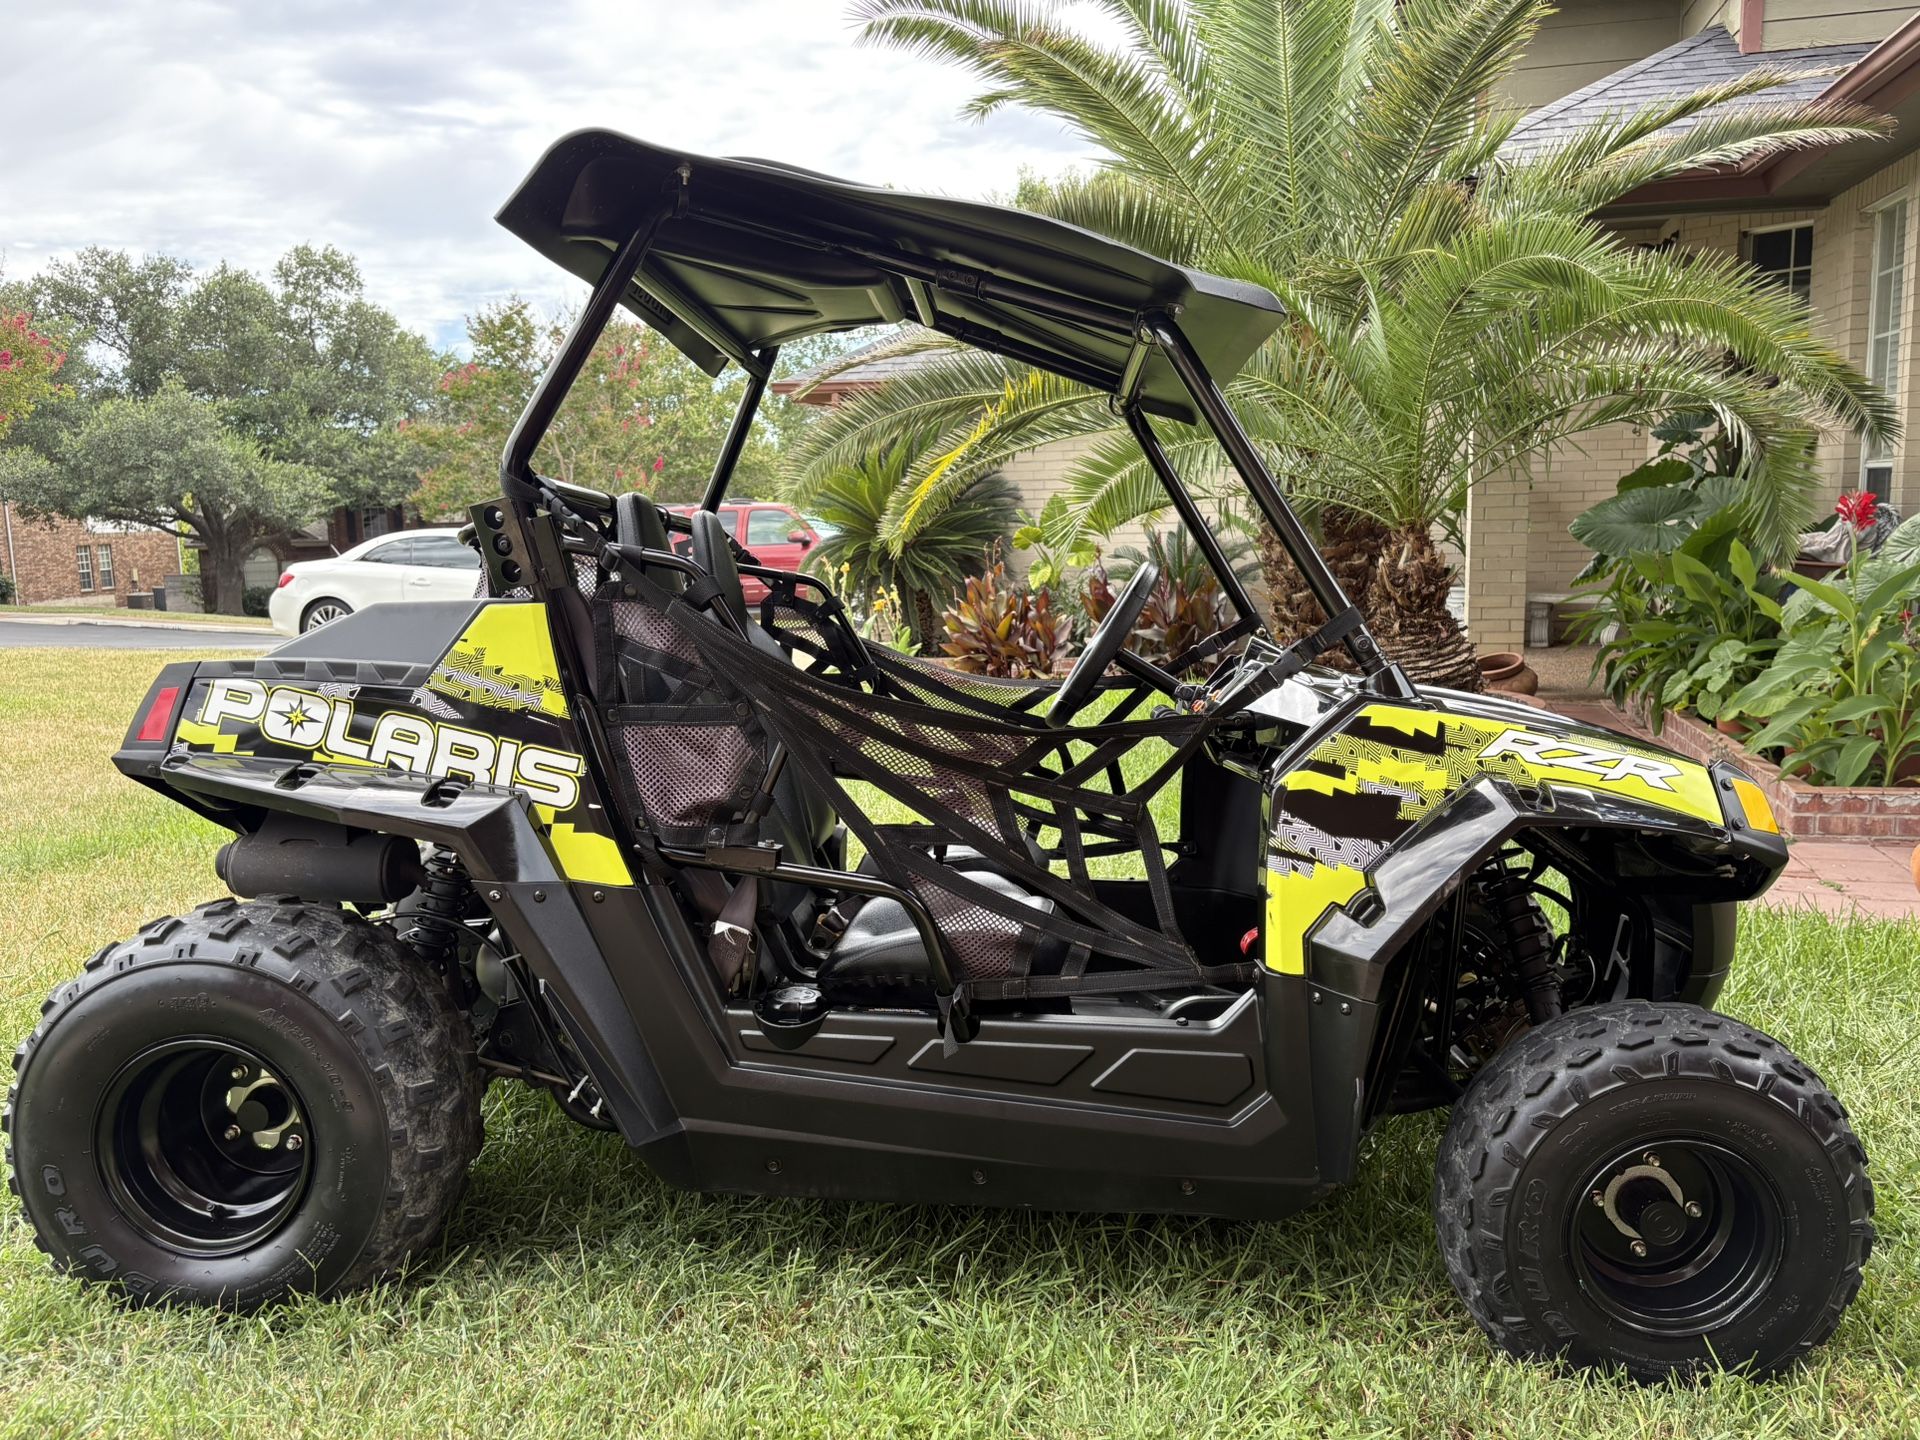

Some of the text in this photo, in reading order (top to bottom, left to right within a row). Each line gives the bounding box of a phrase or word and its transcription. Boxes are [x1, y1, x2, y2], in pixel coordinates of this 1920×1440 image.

[199, 679, 584, 810] POLARIS
[1477, 728, 1683, 792] RZR
[41, 1164, 159, 1296] DURO
